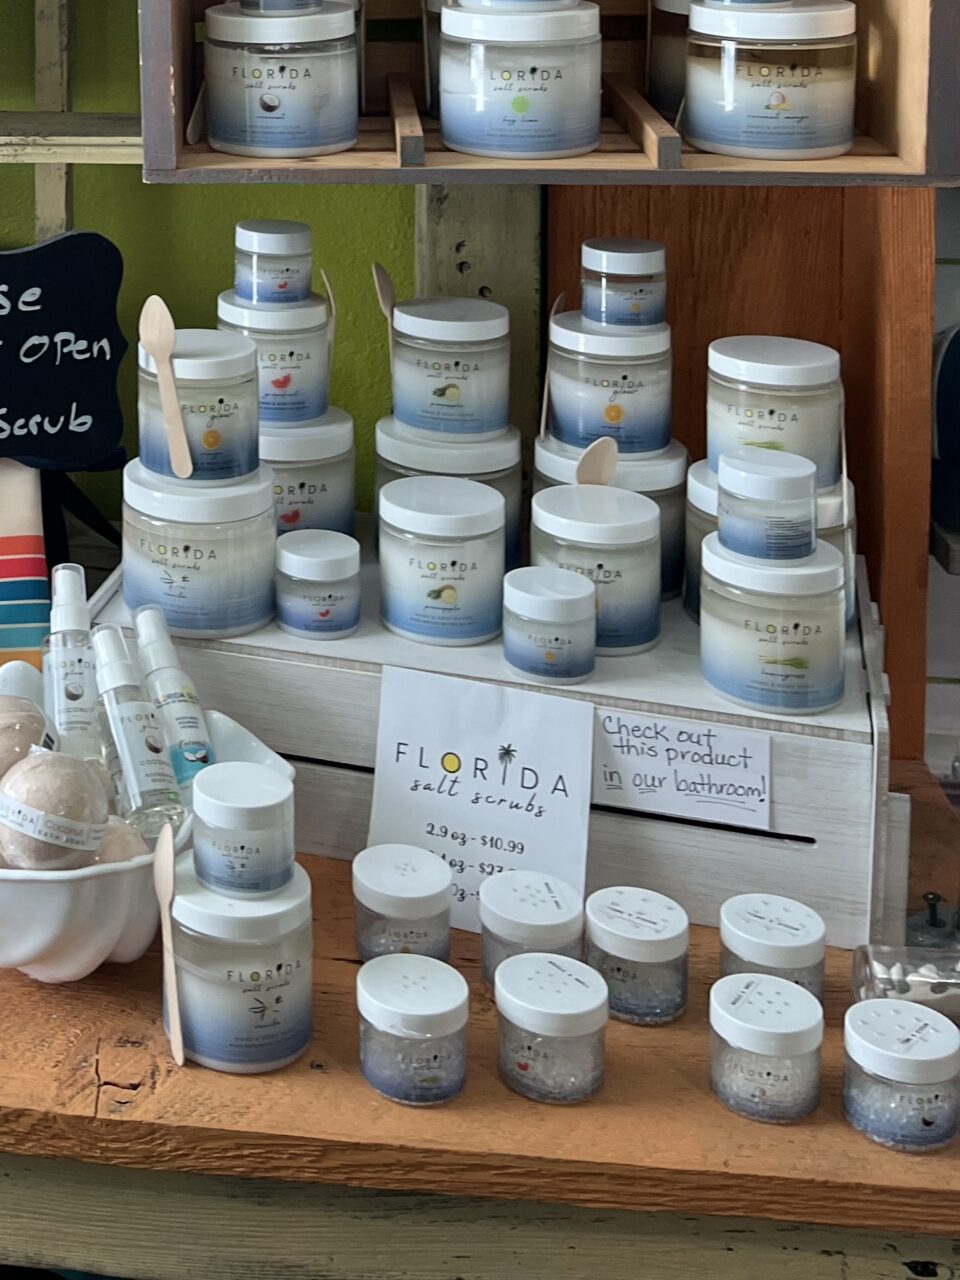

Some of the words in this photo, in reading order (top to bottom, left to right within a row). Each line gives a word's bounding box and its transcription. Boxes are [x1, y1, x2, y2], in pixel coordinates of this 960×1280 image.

[232, 64, 313, 80] FLORIDA
[489, 65, 563, 81] LORIDA
[735, 62, 824, 78] FLORIDA
[259, 350, 312, 362] LORIDA
[416, 358, 480, 373] FLORIDA
[584, 374, 645, 389] FLORIDA
[181, 398, 240, 415] FLORIDA
[727, 403, 799, 422] FLORIDA
[273, 482, 328, 496] ORIDA
[140, 538, 218, 561] FLORIDA
[408, 557, 478, 573] FLORIDA
[744, 619, 822, 636] FLORIDA
[602, 715, 670, 742] Check
[676, 728, 717, 747] out
[613, 736, 659, 758] this
[665, 746, 753, 769] product
[395, 741, 569, 798] FLORIDA
[602, 763, 623, 784] in
[631, 771, 668, 789] our
[674, 768, 767, 803] bathroom!
[410, 773, 461, 797] salt
[470, 792, 547, 818] scrubs
[425, 822, 449, 839] 2.9
[450, 830, 469, 847] oz
[480, 834, 525, 855] $10.99
[212, 840, 261, 855] FLORIDA
[226, 959, 302, 983] FLORIDA
